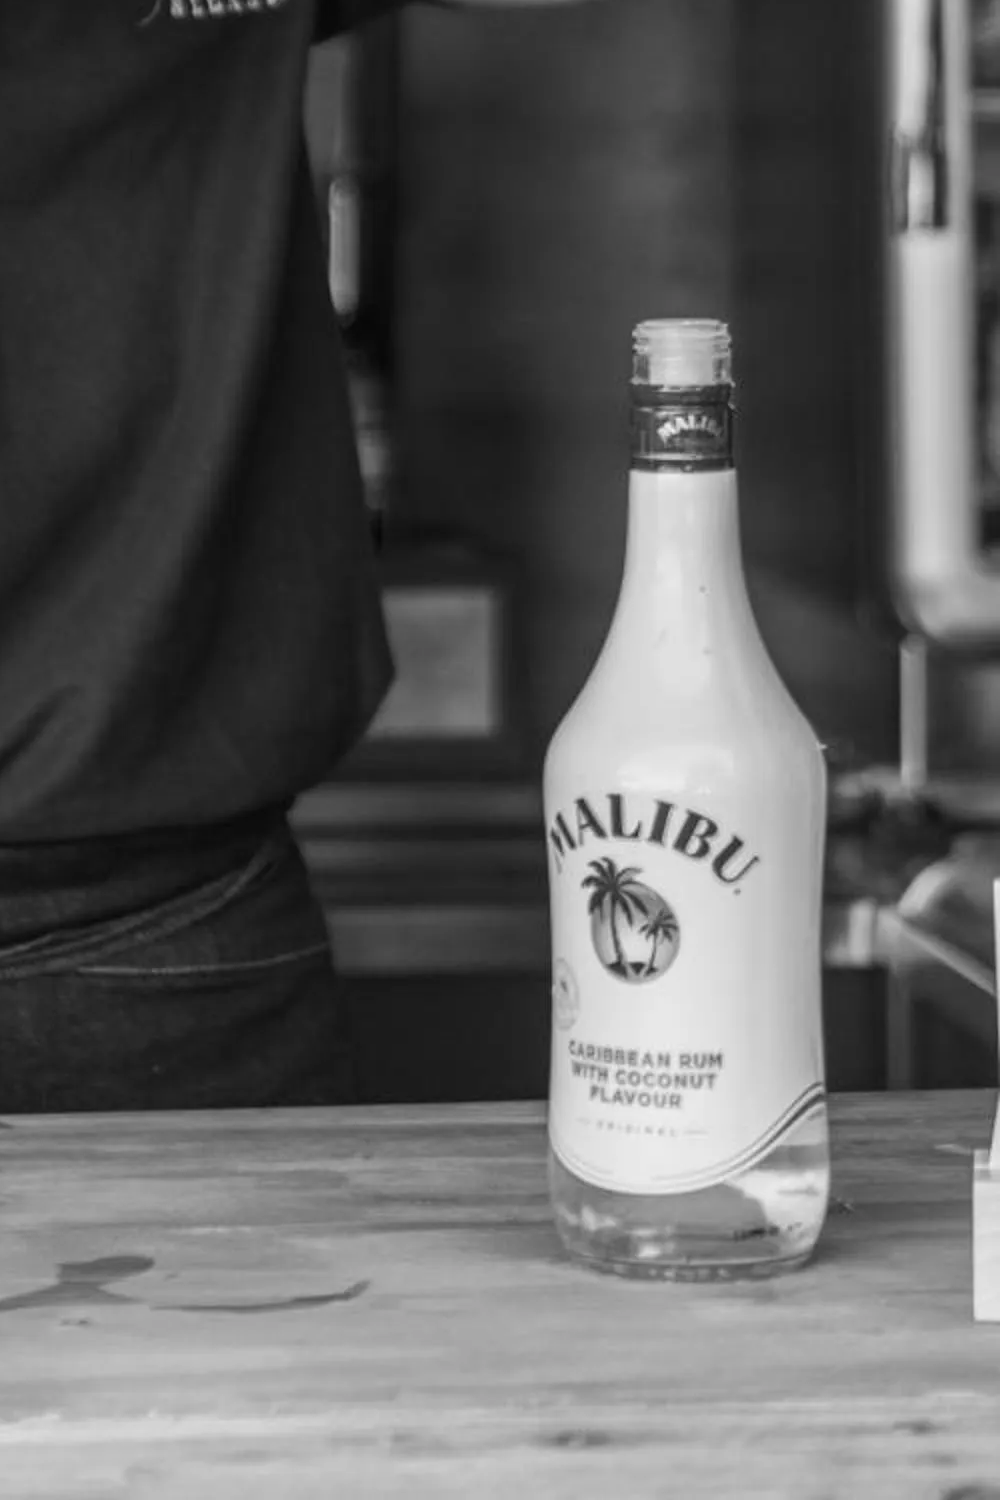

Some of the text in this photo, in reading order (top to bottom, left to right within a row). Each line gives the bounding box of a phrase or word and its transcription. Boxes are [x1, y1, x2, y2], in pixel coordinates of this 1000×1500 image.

[550, 793, 760, 886] MALIBU
[568, 1040, 723, 1069] CARIBBEAN RUM
[571, 1060, 716, 1089] WITH COCONUT
[590, 1085, 682, 1109] FLAVOUR
